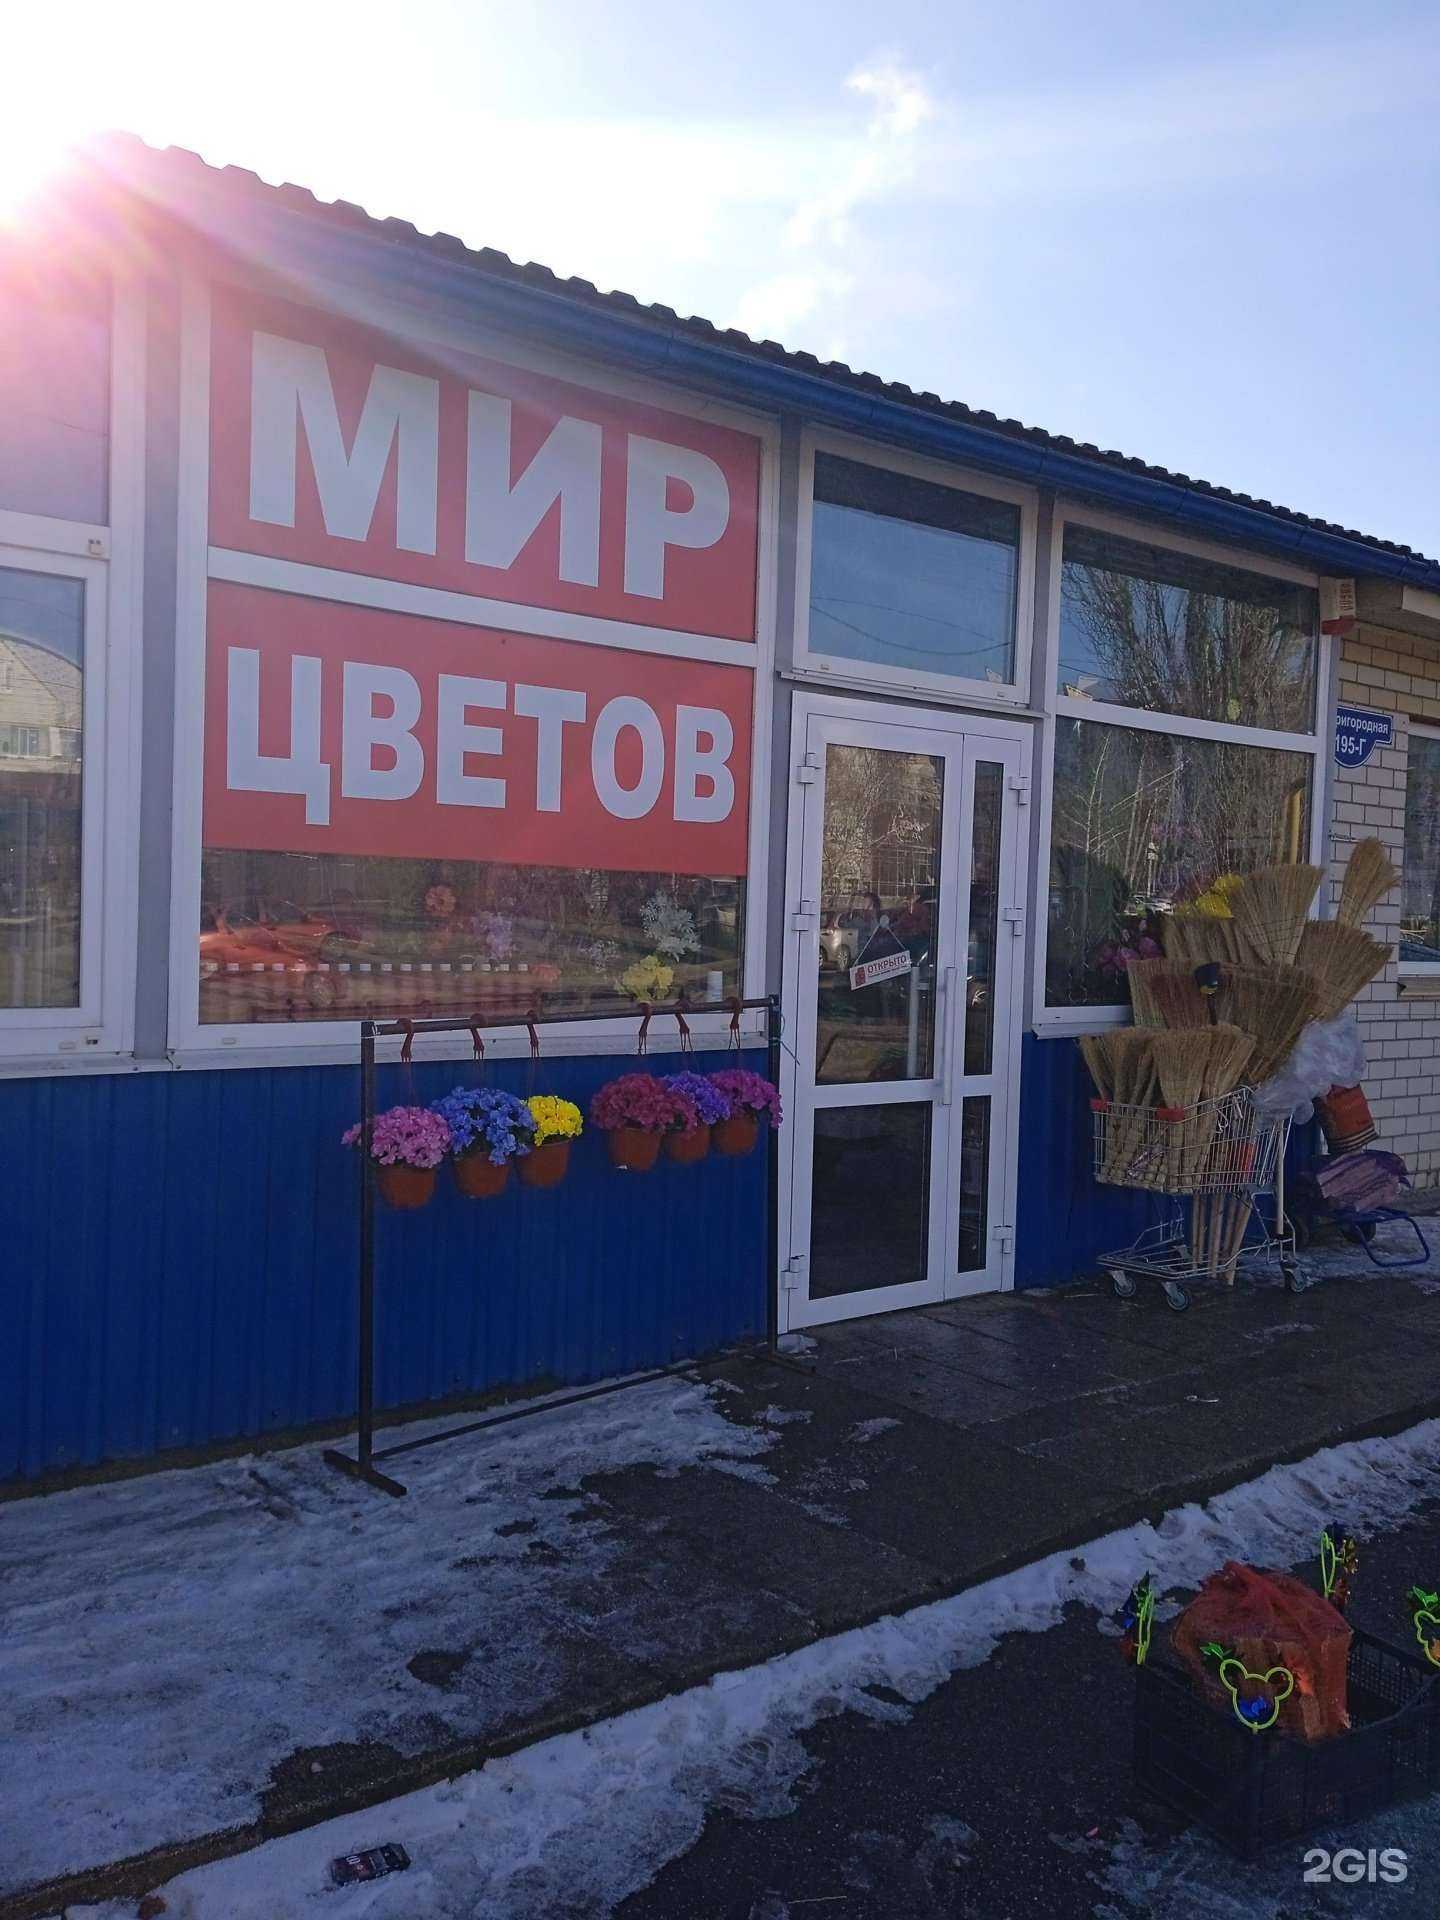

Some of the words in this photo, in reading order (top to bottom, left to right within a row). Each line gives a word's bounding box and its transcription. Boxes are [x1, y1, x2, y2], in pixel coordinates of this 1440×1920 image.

[249, 330, 730, 600] МИР
[226, 646, 735, 825] ЦВЕТОВ
[1336, 715, 1389, 734] ригородная
[1335, 734, 1367, 756] 195-Г
[867, 955, 907, 974] ОТКРЫТО
